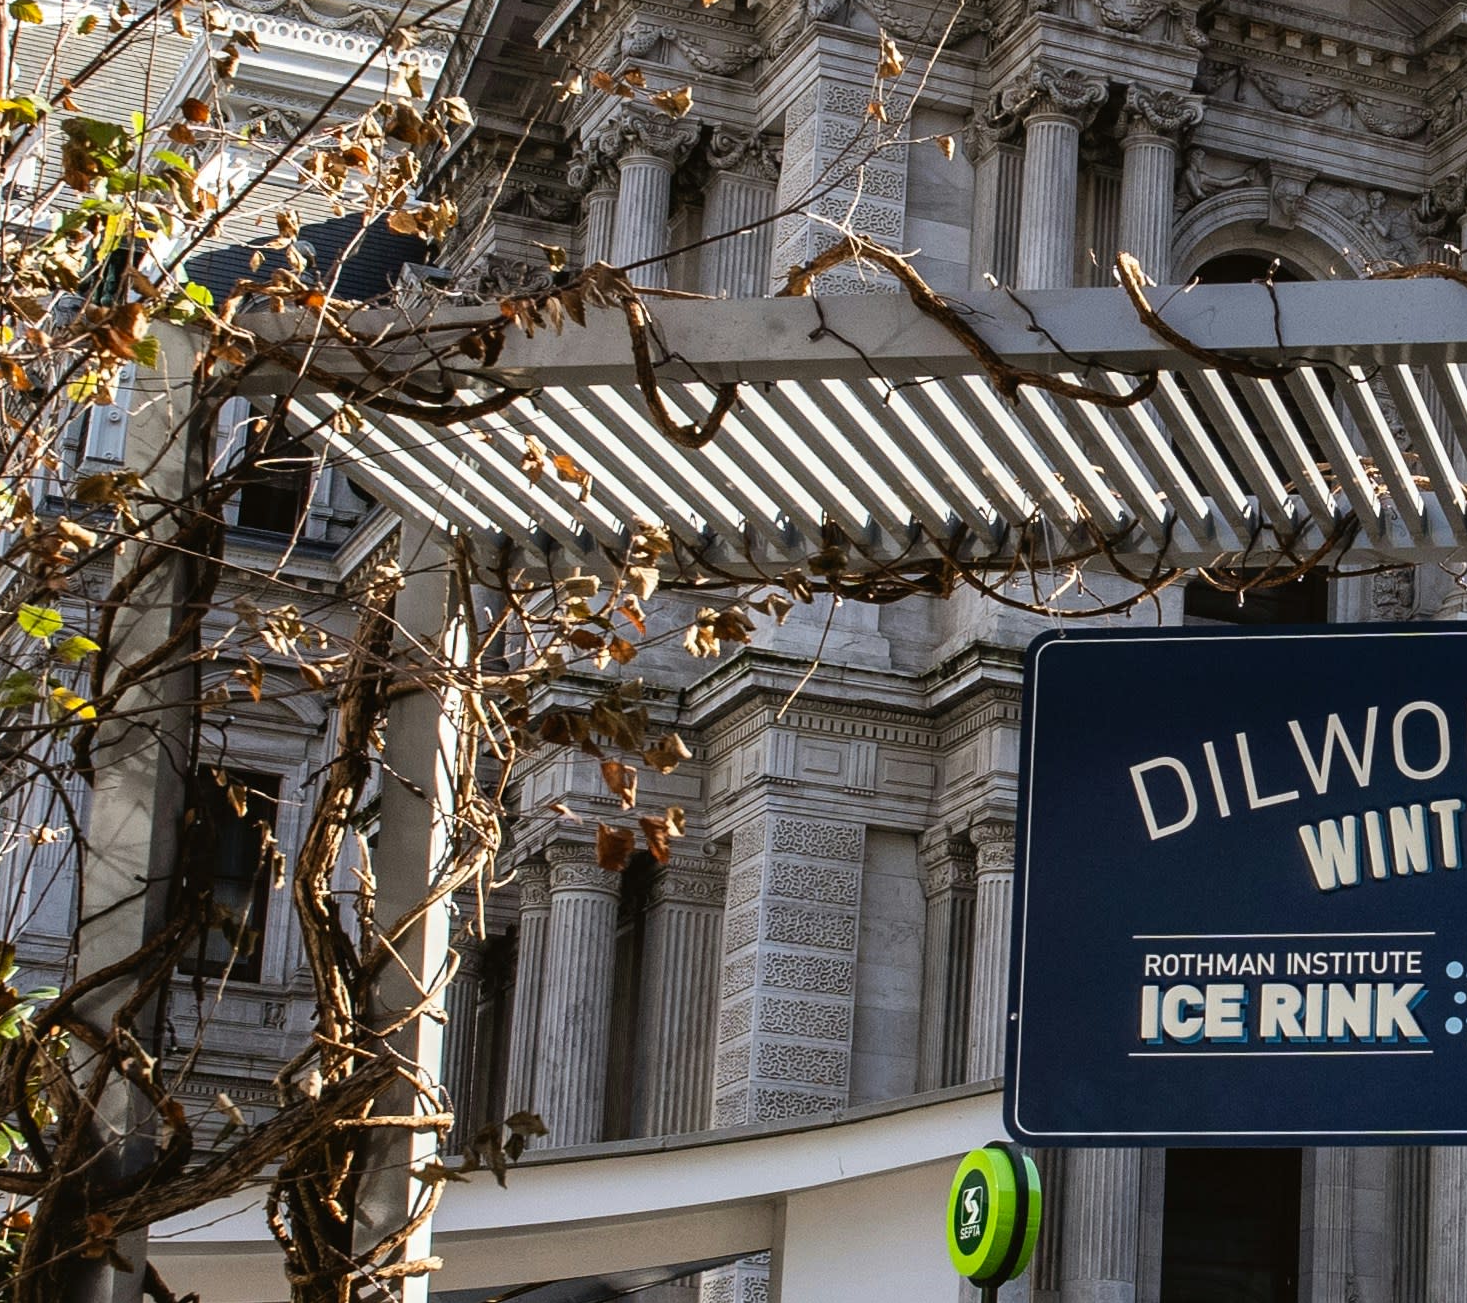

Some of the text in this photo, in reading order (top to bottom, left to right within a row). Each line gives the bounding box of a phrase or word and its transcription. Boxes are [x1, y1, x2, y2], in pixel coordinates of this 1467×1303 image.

[1144, 951, 1422, 977] ROTHMAN INSTITUTE
[1140, 983, 1427, 1040] ICE RINK
[959, 1224, 981, 1239] SEPTA
